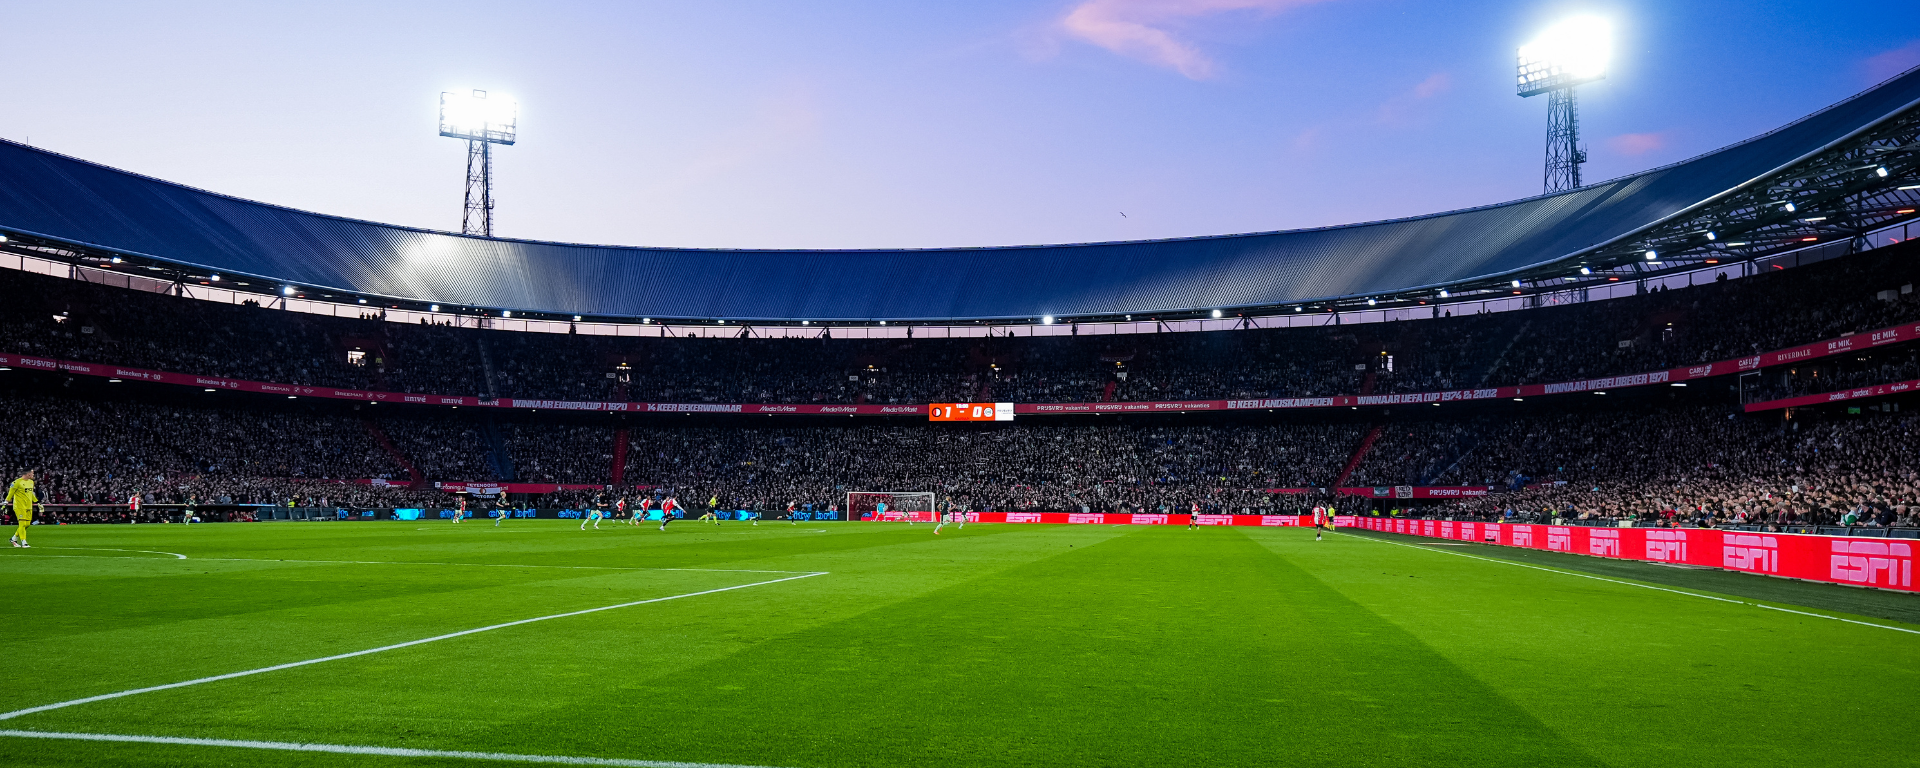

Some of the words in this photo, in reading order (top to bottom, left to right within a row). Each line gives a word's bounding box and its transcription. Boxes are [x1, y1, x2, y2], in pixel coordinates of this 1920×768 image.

[1872, 333, 1880, 341] DE
[1828, 342, 1836, 350] DE
[1778, 349, 1812, 361] RIVERDALE
[1544, 380, 1586, 394] WINNAAR
[1588, 373, 1648, 390] WERELDBEKER
[1648, 371, 1670, 384] 1970
[1357, 394, 1400, 404] WINNAAR
[1401, 394, 1423, 403] UEFA
[1424, 392, 1440, 402] CUP
[1442, 391, 1462, 400] 1974
[1473, 389, 1498, 398] 2002
[512, 400, 554, 408] WINNAAR
[608, 402, 628, 410] 1970
[657, 404, 678, 412] KEER
[1237, 400, 1259, 408] KEER
[945, 406, 952, 418] 1
[972, 406, 982, 418] 0
[1006, 513, 1041, 522] ESPN
[1068, 514, 1104, 523] ESPN
[1132, 515, 1168, 524] ESPN
[1261, 516, 1300, 526] ESPN
[1441, 522, 1453, 538] ESPN
[1462, 523, 1474, 540] ESPN
[1485, 524, 1500, 544] ESPN
[1513, 525, 1532, 546] ESPN
[1548, 527, 1570, 550] ESPN
[1590, 529, 1619, 556] ESPN
[1646, 530, 1686, 561] ESPN
[1724, 534, 1778, 572] ESPN
[1831, 540, 1912, 587] ESPN
